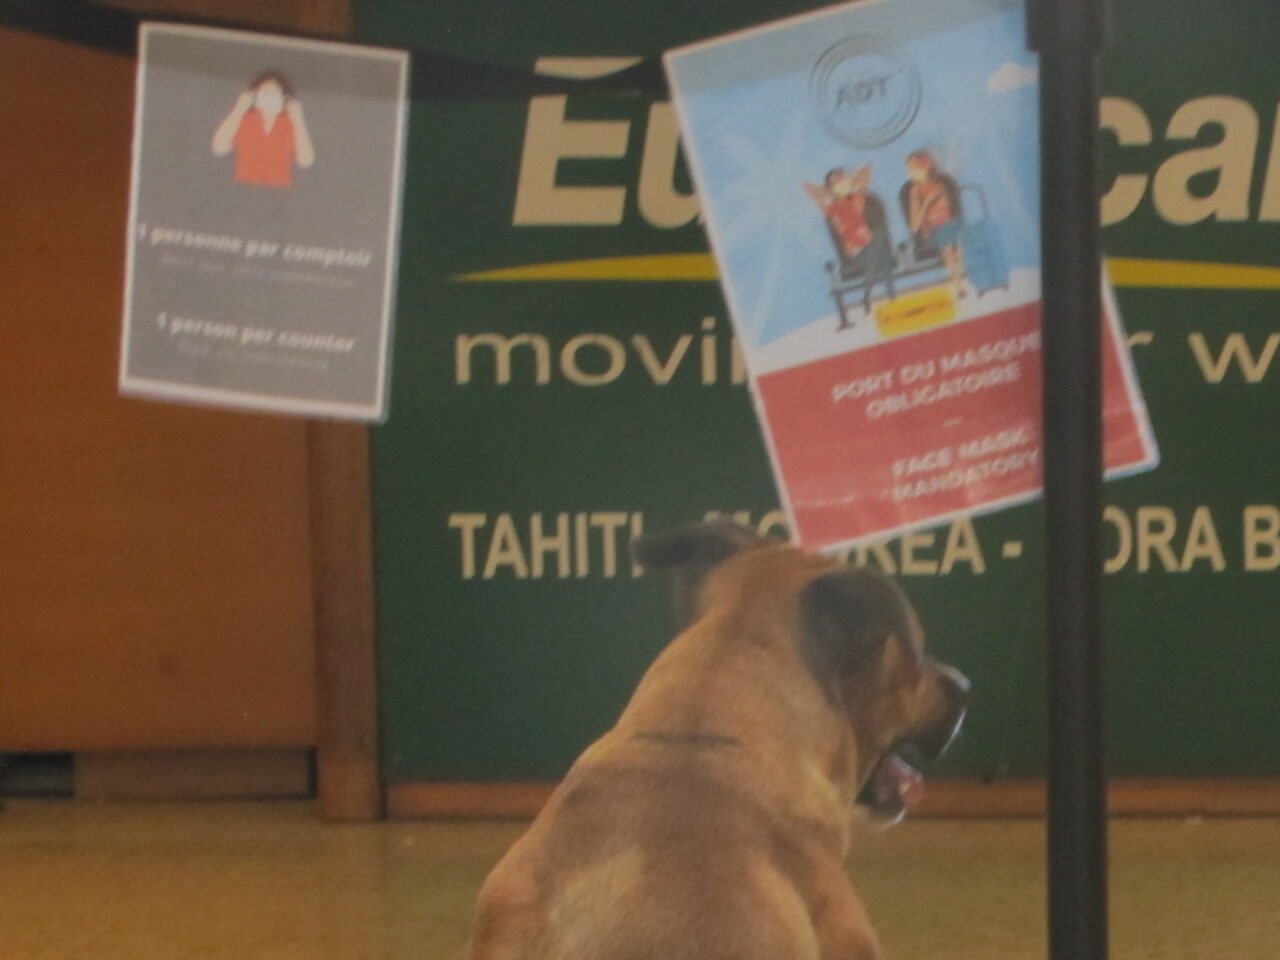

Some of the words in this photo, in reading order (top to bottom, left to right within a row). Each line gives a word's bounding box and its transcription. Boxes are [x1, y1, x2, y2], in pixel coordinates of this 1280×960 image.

[151, 229, 242, 252] personne
[245, 239, 280, 258] par
[283, 245, 372, 268] comptoir
[170, 316, 239, 338] person
[240, 325, 275, 345] per
[277, 334, 356, 353] counter
[454, 317, 754, 386] movi
[832, 371, 894, 402] PORT
[898, 360, 937, 386] DU
[865, 361, 1021, 420] OBLIGATOIRE
[892, 447, 953, 476] FACE
[958, 427, 1029, 458] MASK
[1103, 505, 1226, 574] ORA
